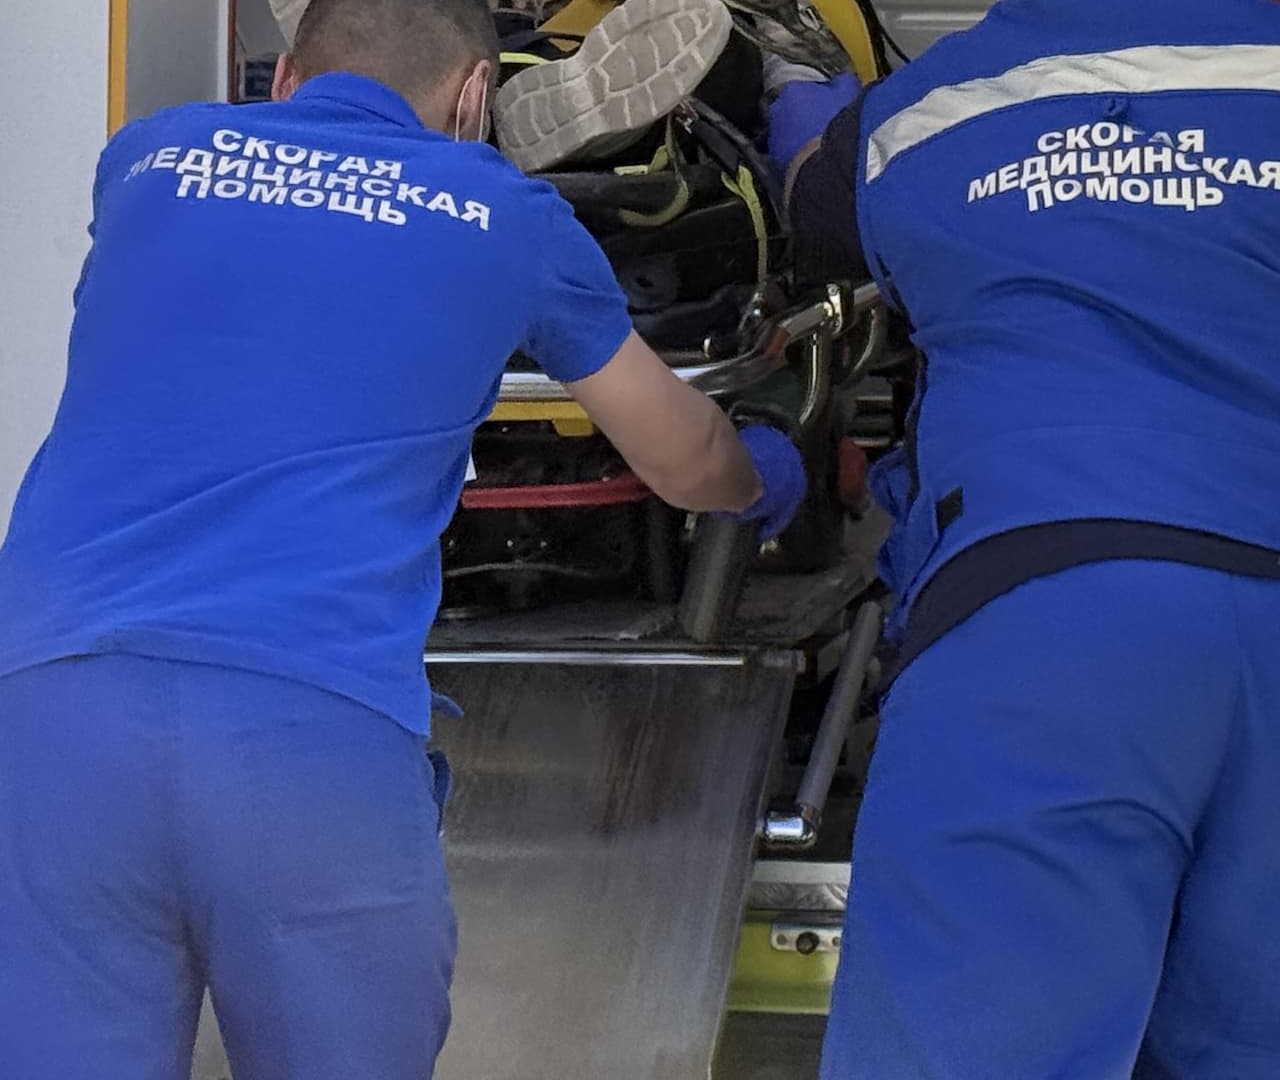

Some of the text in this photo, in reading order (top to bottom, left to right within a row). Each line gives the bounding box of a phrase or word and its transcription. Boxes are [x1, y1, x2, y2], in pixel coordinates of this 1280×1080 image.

[212, 128, 403, 181] СКОРАЯ
[125, 146, 491, 231] МЕДИЦИНСКАЯ
[176, 175, 407, 227] ПОМОЩЬ
[1027, 176, 1224, 212] ПОМОЩЬ
